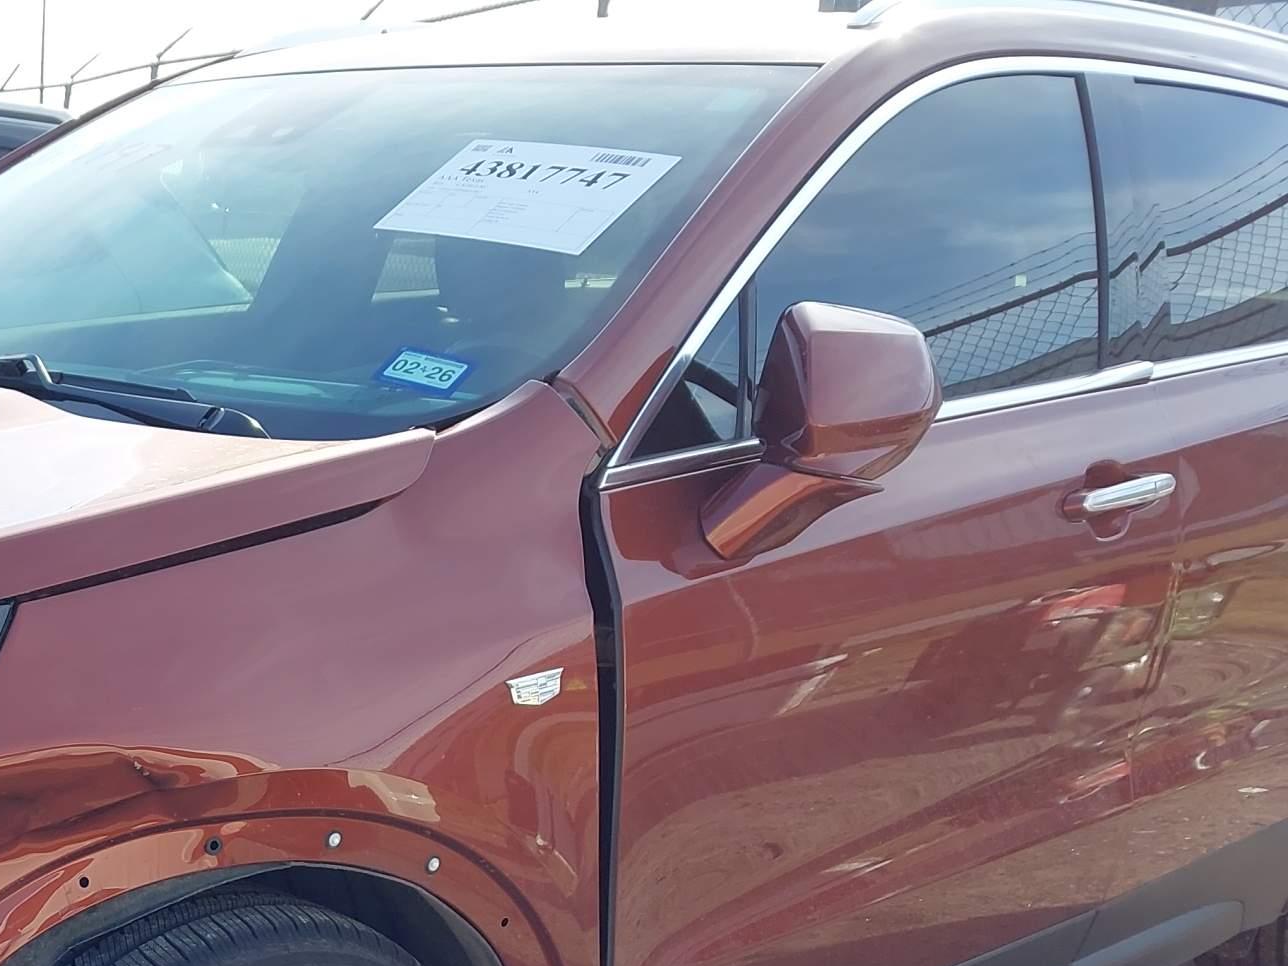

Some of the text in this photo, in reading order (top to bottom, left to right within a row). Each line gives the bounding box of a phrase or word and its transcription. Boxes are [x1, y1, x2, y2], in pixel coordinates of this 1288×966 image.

[460, 159, 632, 190] 43817747
[392, 359, 421, 375] 02
[424, 366, 456, 382] 26
